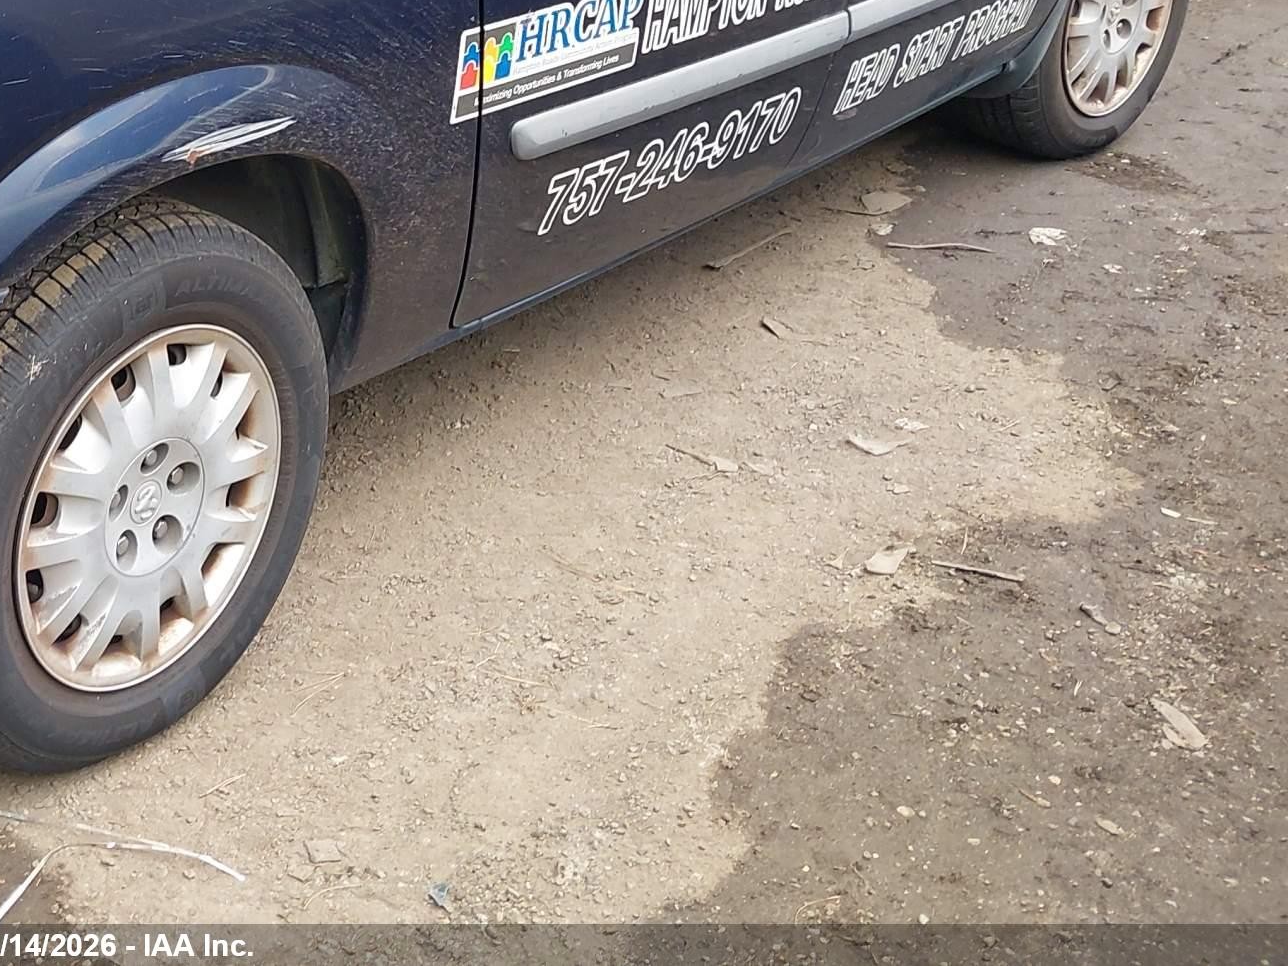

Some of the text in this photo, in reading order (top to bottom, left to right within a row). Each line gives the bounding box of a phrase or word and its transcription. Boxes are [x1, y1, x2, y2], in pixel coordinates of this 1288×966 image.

[513, 73, 556, 96] Opportunities
[562, 58, 603, 80] Transforming
[603, 54, 620, 68] Lives
[832, 44, 901, 115] HEAD
[893, 16, 965, 88] START
[538, 87, 802, 236] 757-246-9170
